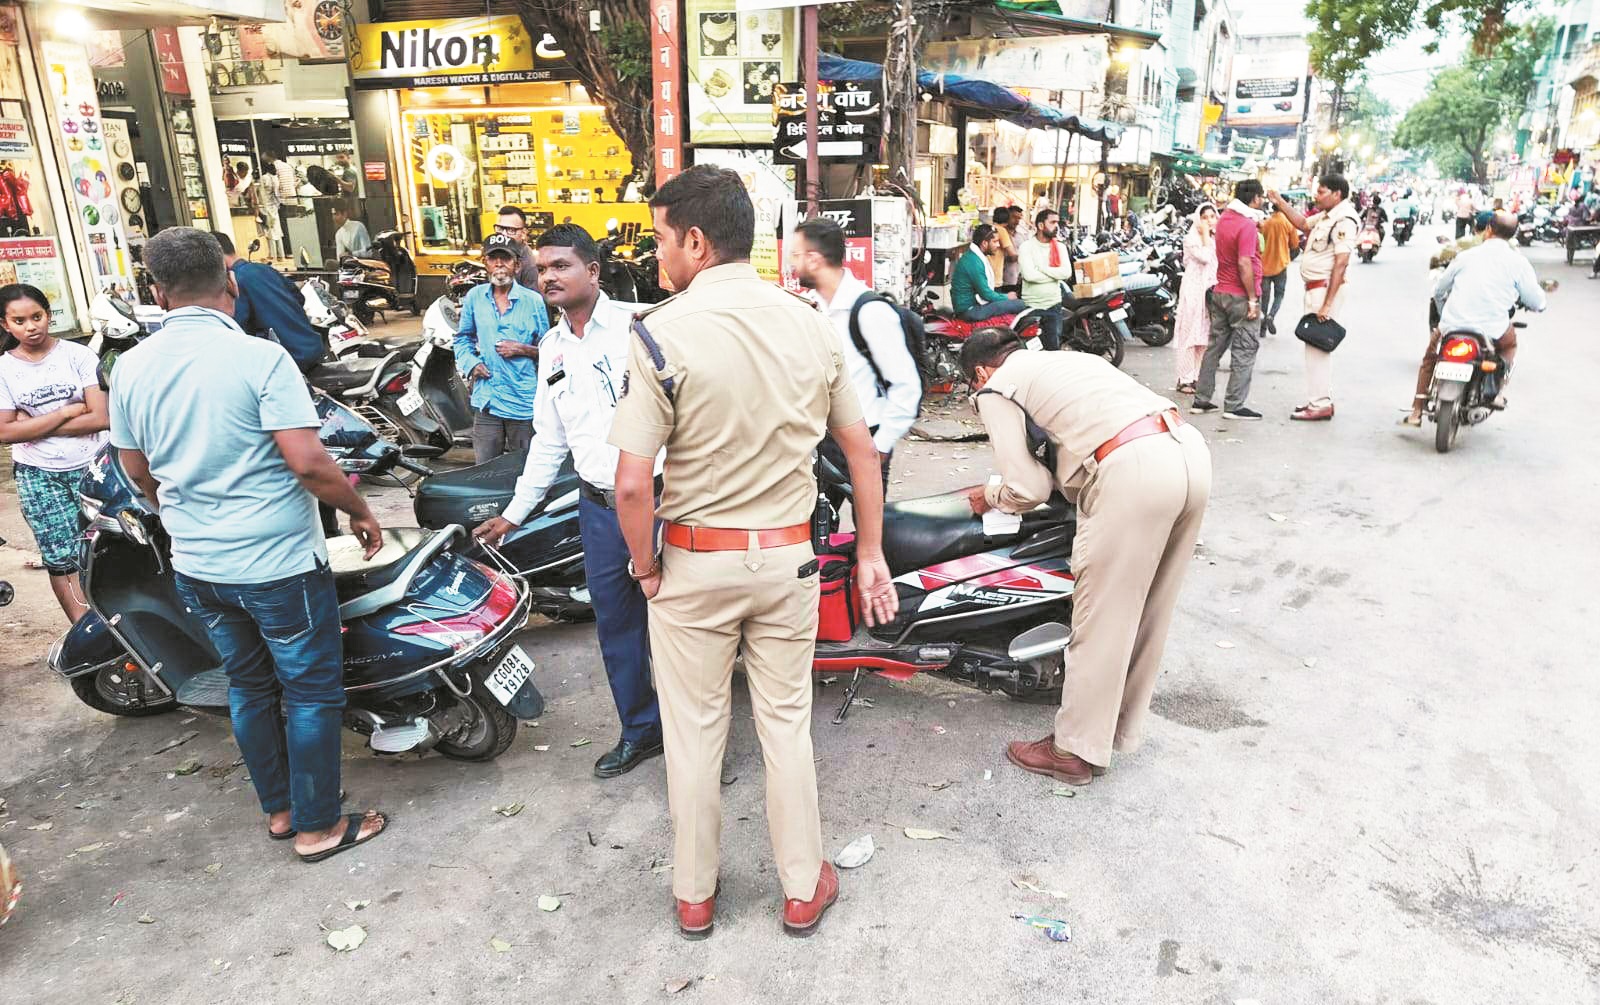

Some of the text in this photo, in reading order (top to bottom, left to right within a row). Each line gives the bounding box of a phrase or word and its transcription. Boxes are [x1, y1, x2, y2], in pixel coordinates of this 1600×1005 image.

[380, 28, 495, 69] Nikon
[413, 71, 551, 86] NARESH WATCH & DIGITAL ZONE
[833, 82, 873, 107] वॉच
[819, 111, 829, 122] &
[836, 121, 865, 135] जोन
[228, 144, 246, 152] TITAN
[295, 144, 315, 153] TITAN
[489, 234, 511, 246] BOY
[493, 653, 521, 686] CG08A
[502, 663, 530, 695] Y9128
